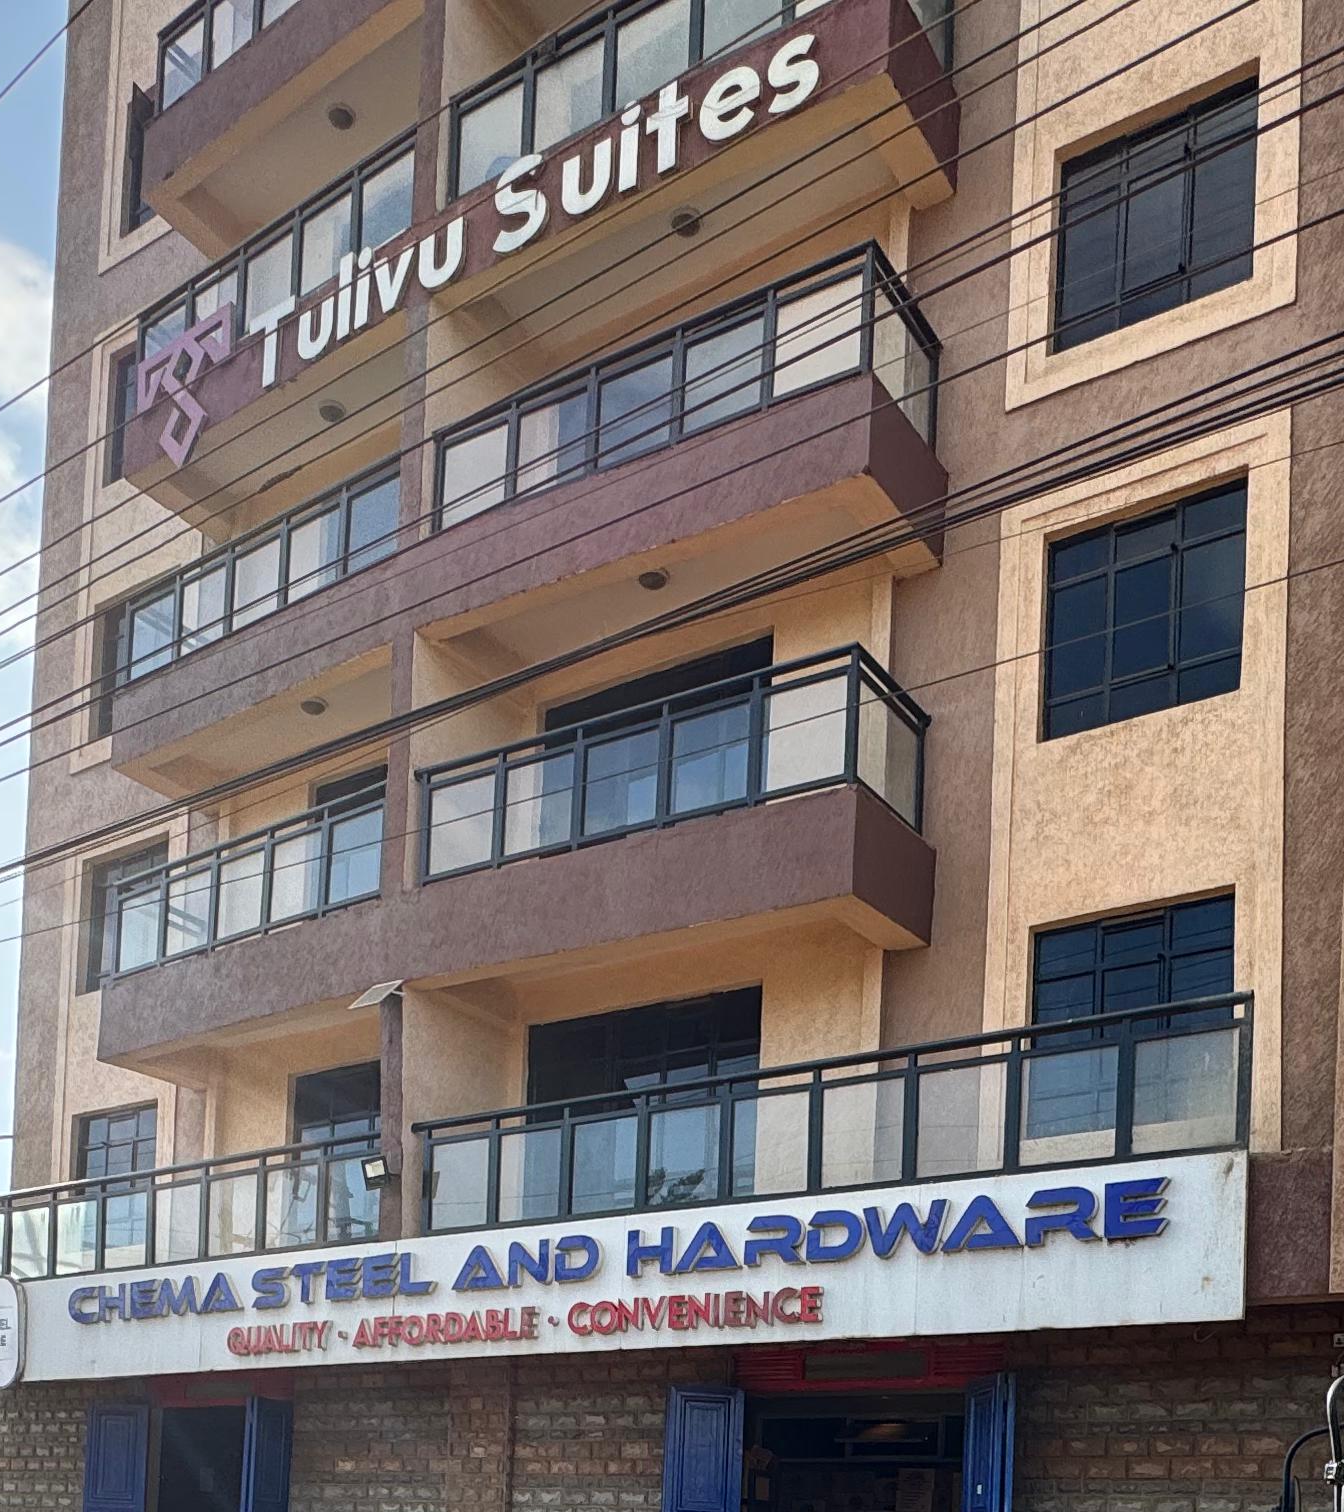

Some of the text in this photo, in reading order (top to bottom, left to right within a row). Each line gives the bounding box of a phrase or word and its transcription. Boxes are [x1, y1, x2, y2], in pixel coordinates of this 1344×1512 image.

[249, 34, 821, 389] Tulivu Suites
[68, 1176, 1171, 1324] CHEMA STEEL AND HARDWARE
[227, 1286, 825, 1356] QUALITY AFFORDABLE CONVENIENCE
